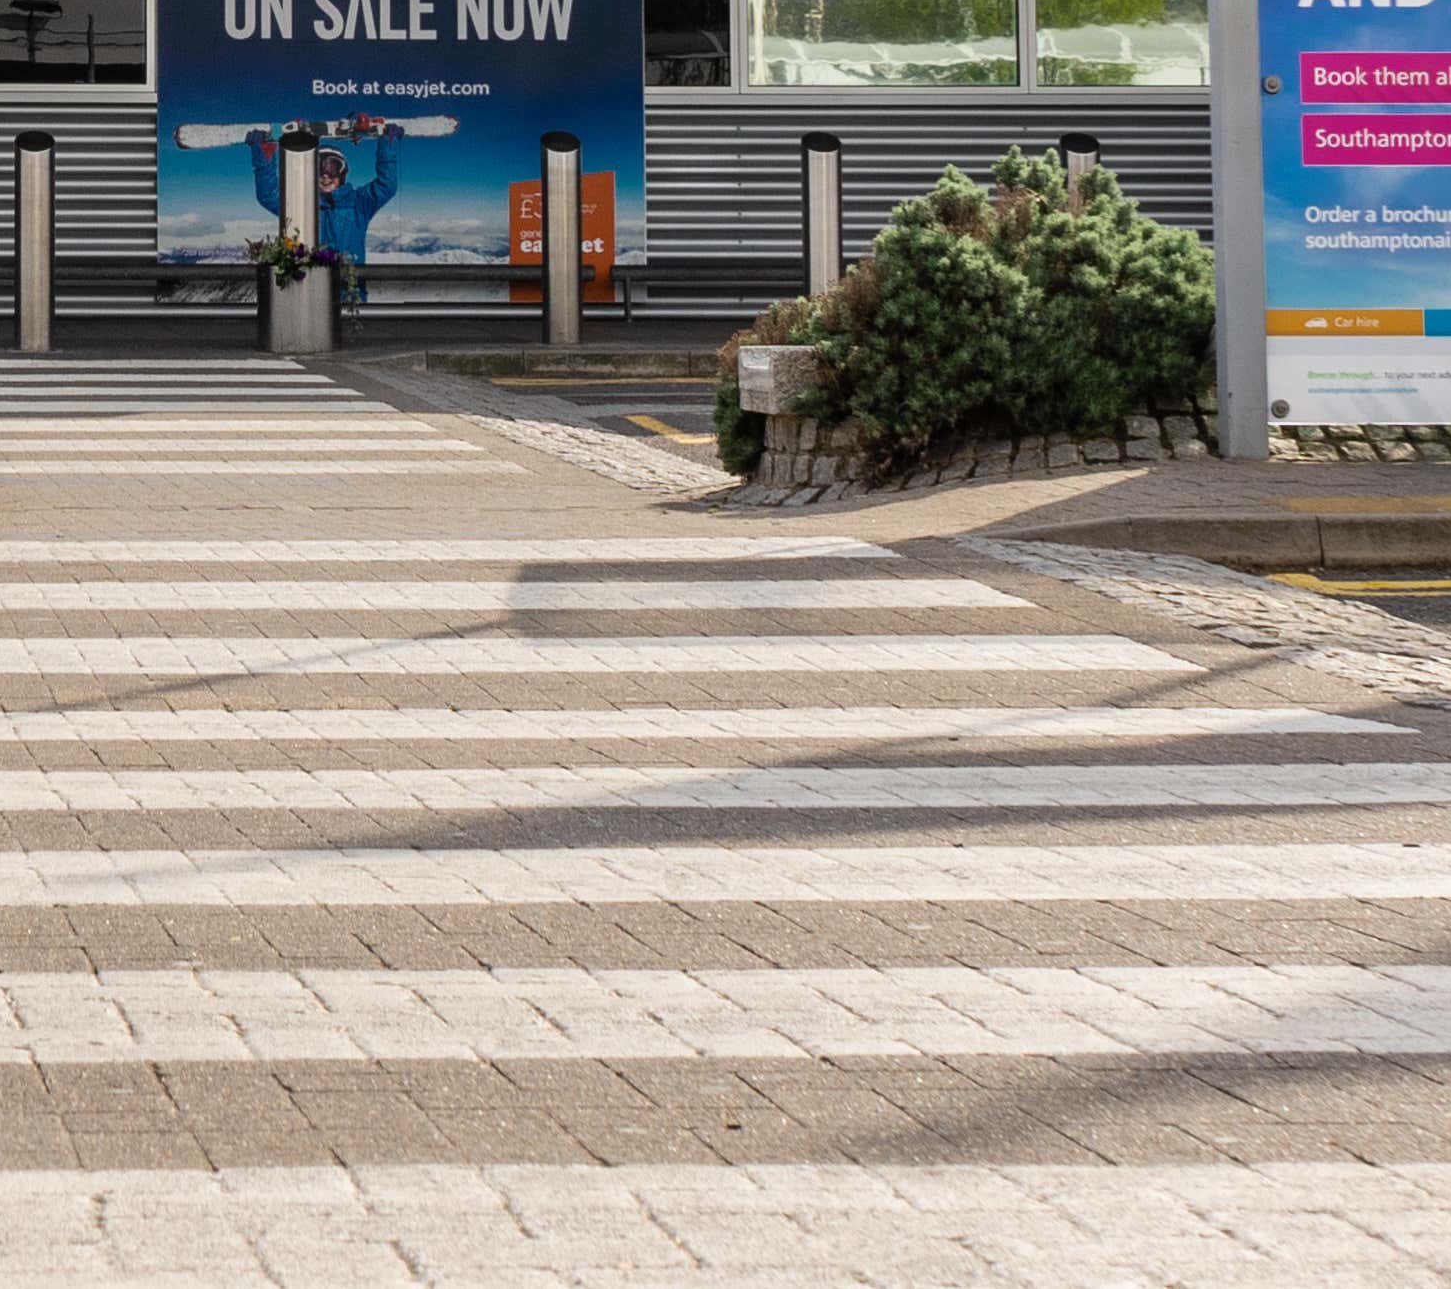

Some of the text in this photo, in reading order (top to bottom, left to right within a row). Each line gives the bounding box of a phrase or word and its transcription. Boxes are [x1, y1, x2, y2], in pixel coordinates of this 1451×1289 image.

[1313, 67, 1367, 86] Book
[1373, 67, 1429, 86] them
[312, 79, 490, 99] Book at easyjet.com
[1305, 206, 1361, 224] Order
[1364, 210, 1378, 224] a
[1334, 315, 1380, 328] Car hire
